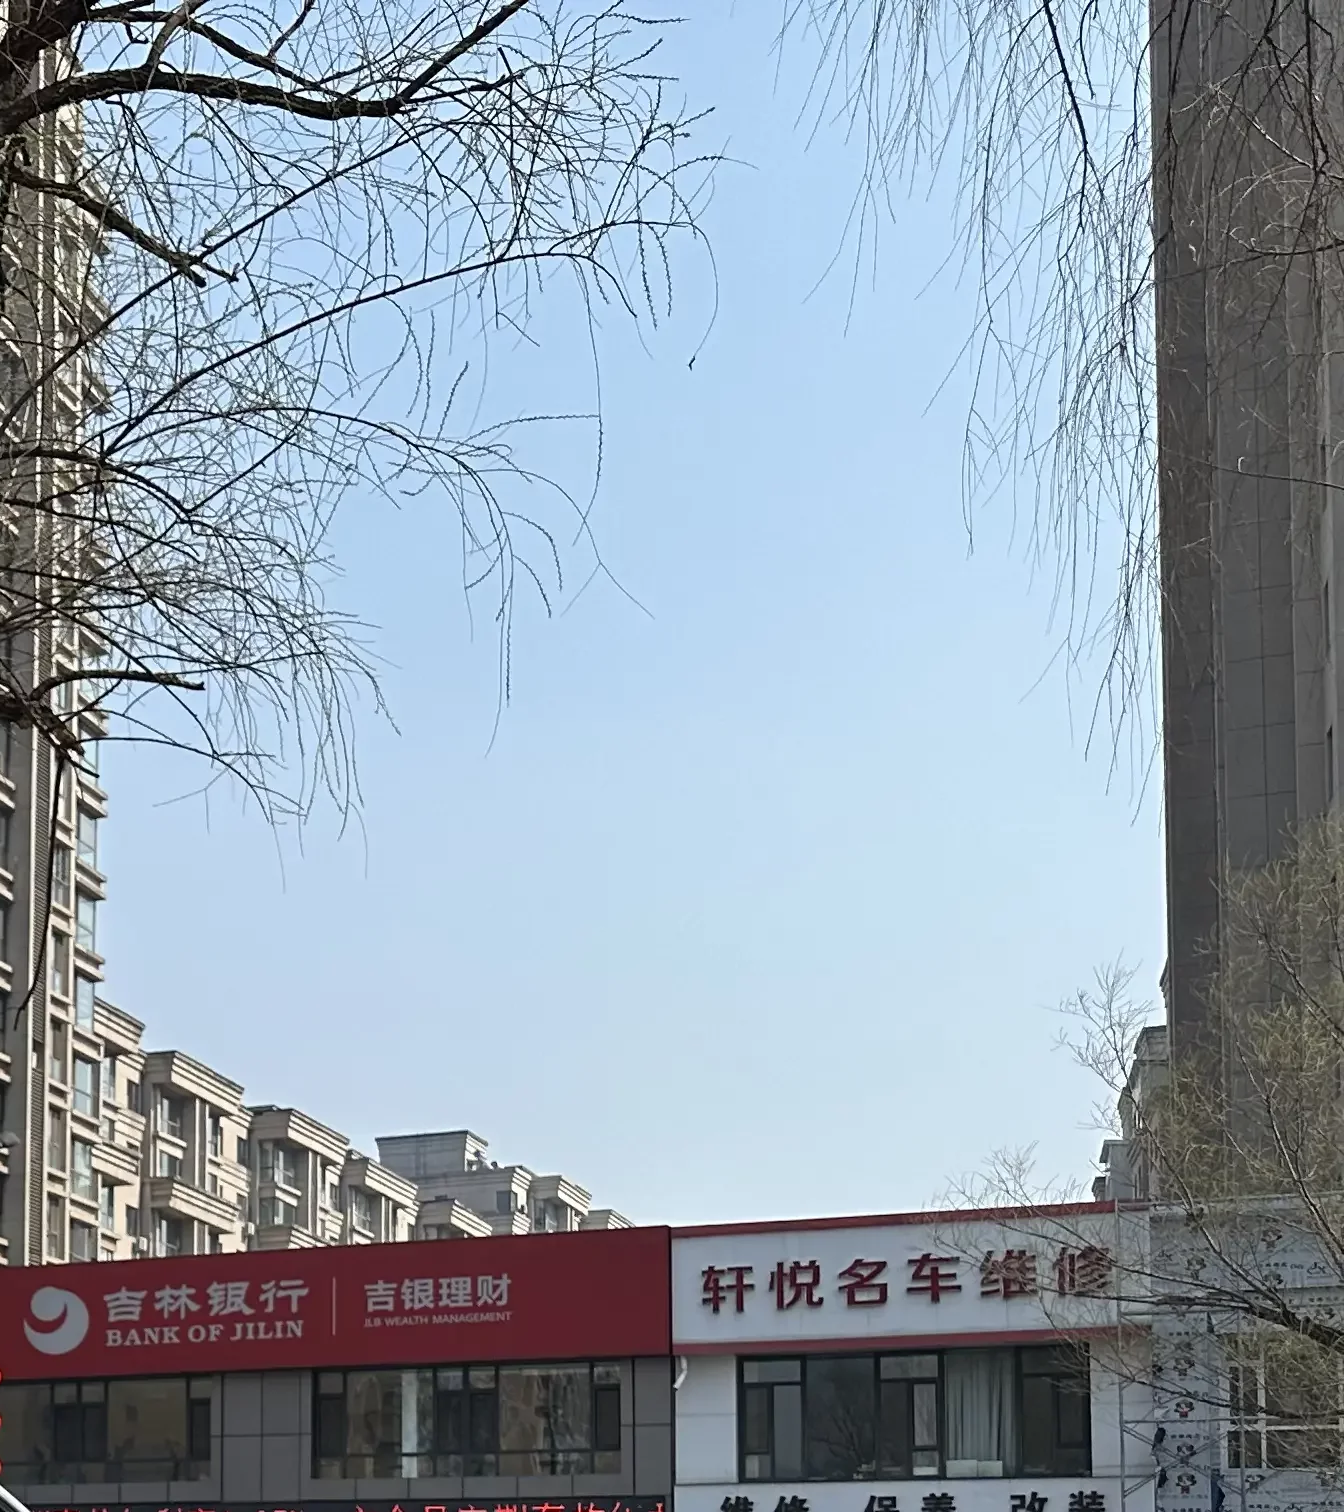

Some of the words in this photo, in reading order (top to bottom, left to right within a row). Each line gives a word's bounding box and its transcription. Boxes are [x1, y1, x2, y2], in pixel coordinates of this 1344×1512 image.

[364, 1273, 512, 1313] 吉银理财
[702, 1246, 1115, 1313] 轩悦名车维修
[103, 1279, 310, 1323] 吉林银行
[384, 1315, 429, 1327] WEALTH
[432, 1311, 512, 1324] MANAGEMENT
[106, 1325, 181, 1347] BANK
[187, 1324, 224, 1343] OF
[230, 1320, 304, 1341] JILIN
